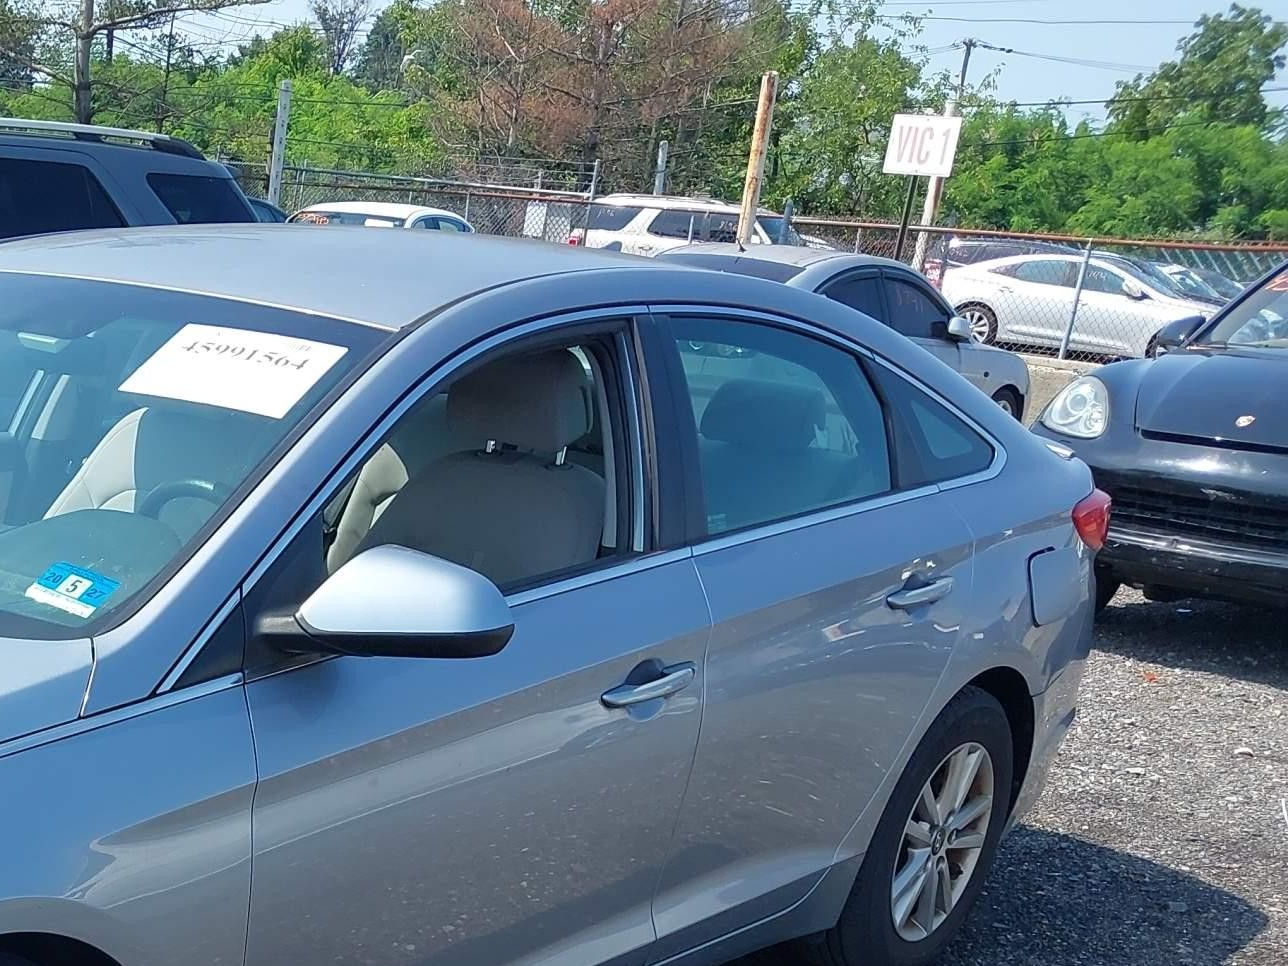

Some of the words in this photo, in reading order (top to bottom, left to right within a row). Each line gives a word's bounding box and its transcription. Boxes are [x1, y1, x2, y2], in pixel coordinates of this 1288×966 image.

[897, 125, 934, 165] VIC
[939, 127, 952, 166] 1
[182, 340, 310, 370] 45991564
[44, 571, 63, 584] 20
[66, 579, 83, 593] 5
[86, 588, 107, 600] 27
